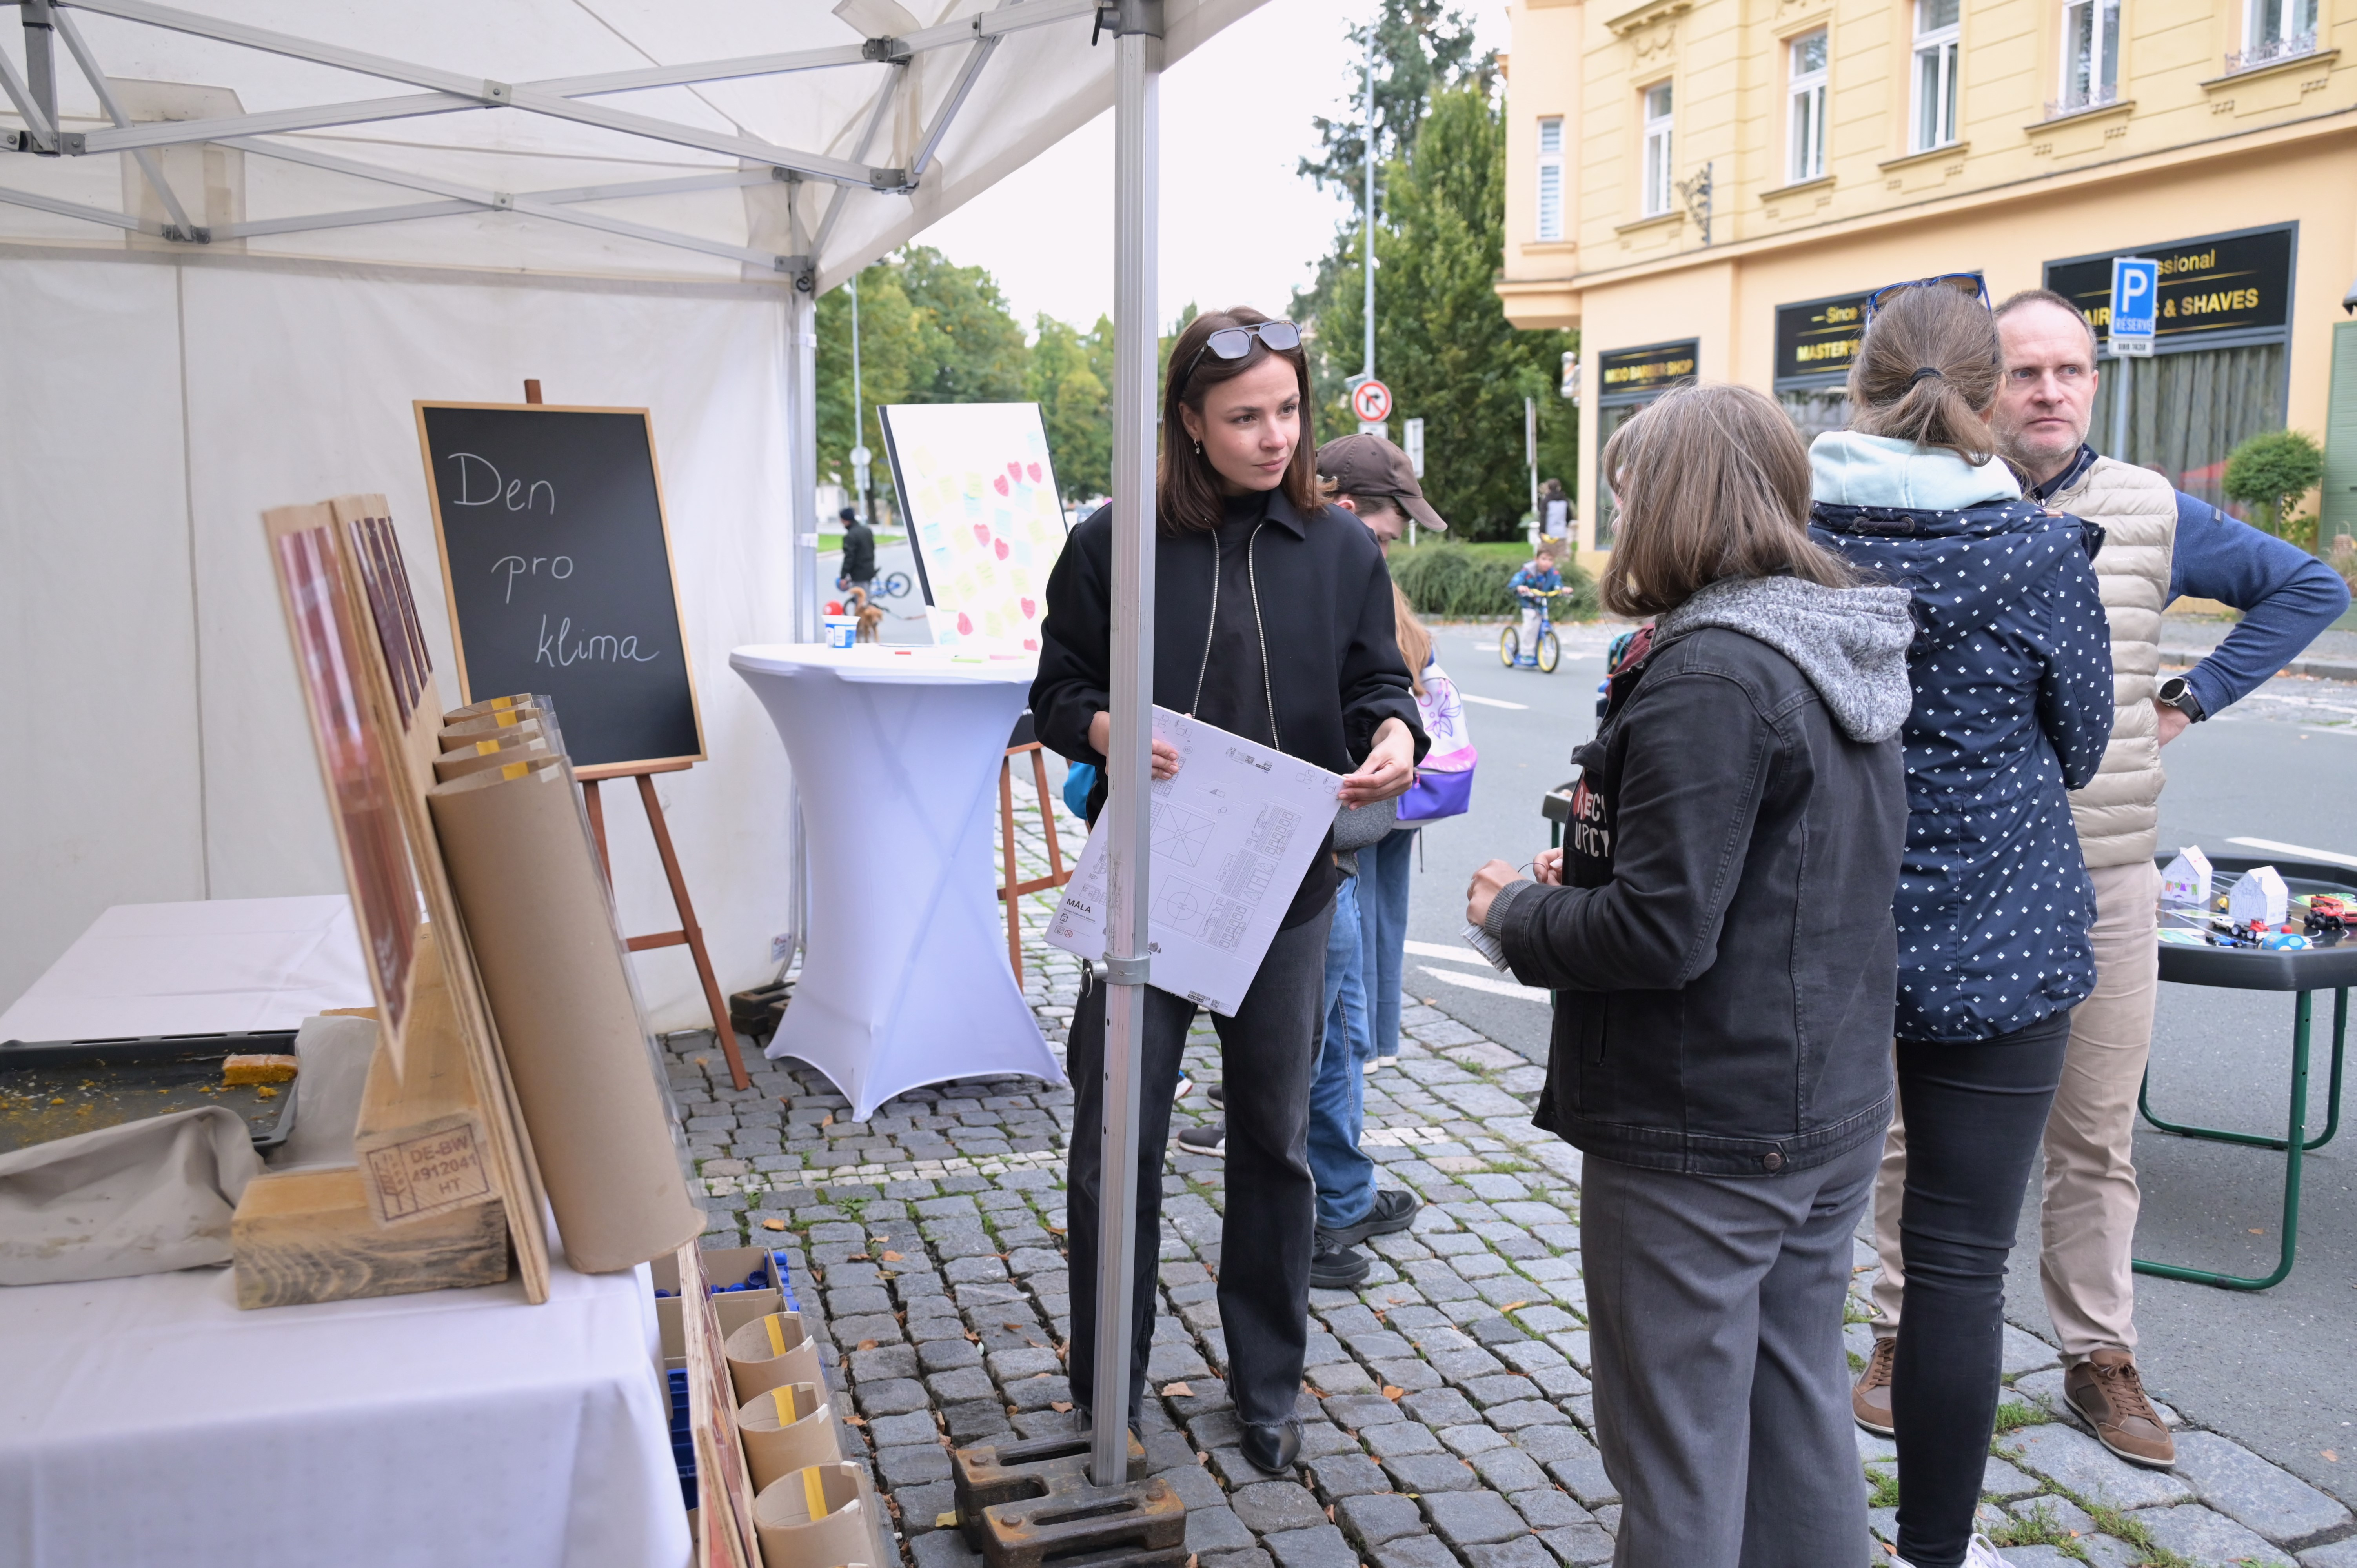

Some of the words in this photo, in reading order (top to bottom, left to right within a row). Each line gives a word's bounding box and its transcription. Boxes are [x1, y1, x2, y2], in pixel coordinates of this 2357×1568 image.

[2157, 248, 2216, 275] ssional
[2122, 269, 2148, 313] P
[2163, 297, 2177, 318] &
[2180, 287, 2259, 316] SHAVES
[1826, 306, 1858, 324] Since
[1667, 358, 1694, 376] SHOP
[448, 453, 555, 515] Den
[491, 555, 573, 604] pro
[535, 614, 660, 668] klima
[1066, 898, 1091, 913] MÅLA
[410, 1135, 468, 1164] DE-BW
[413, 1153, 477, 1182] 4912041
[438, 1177, 461, 1194] HT
